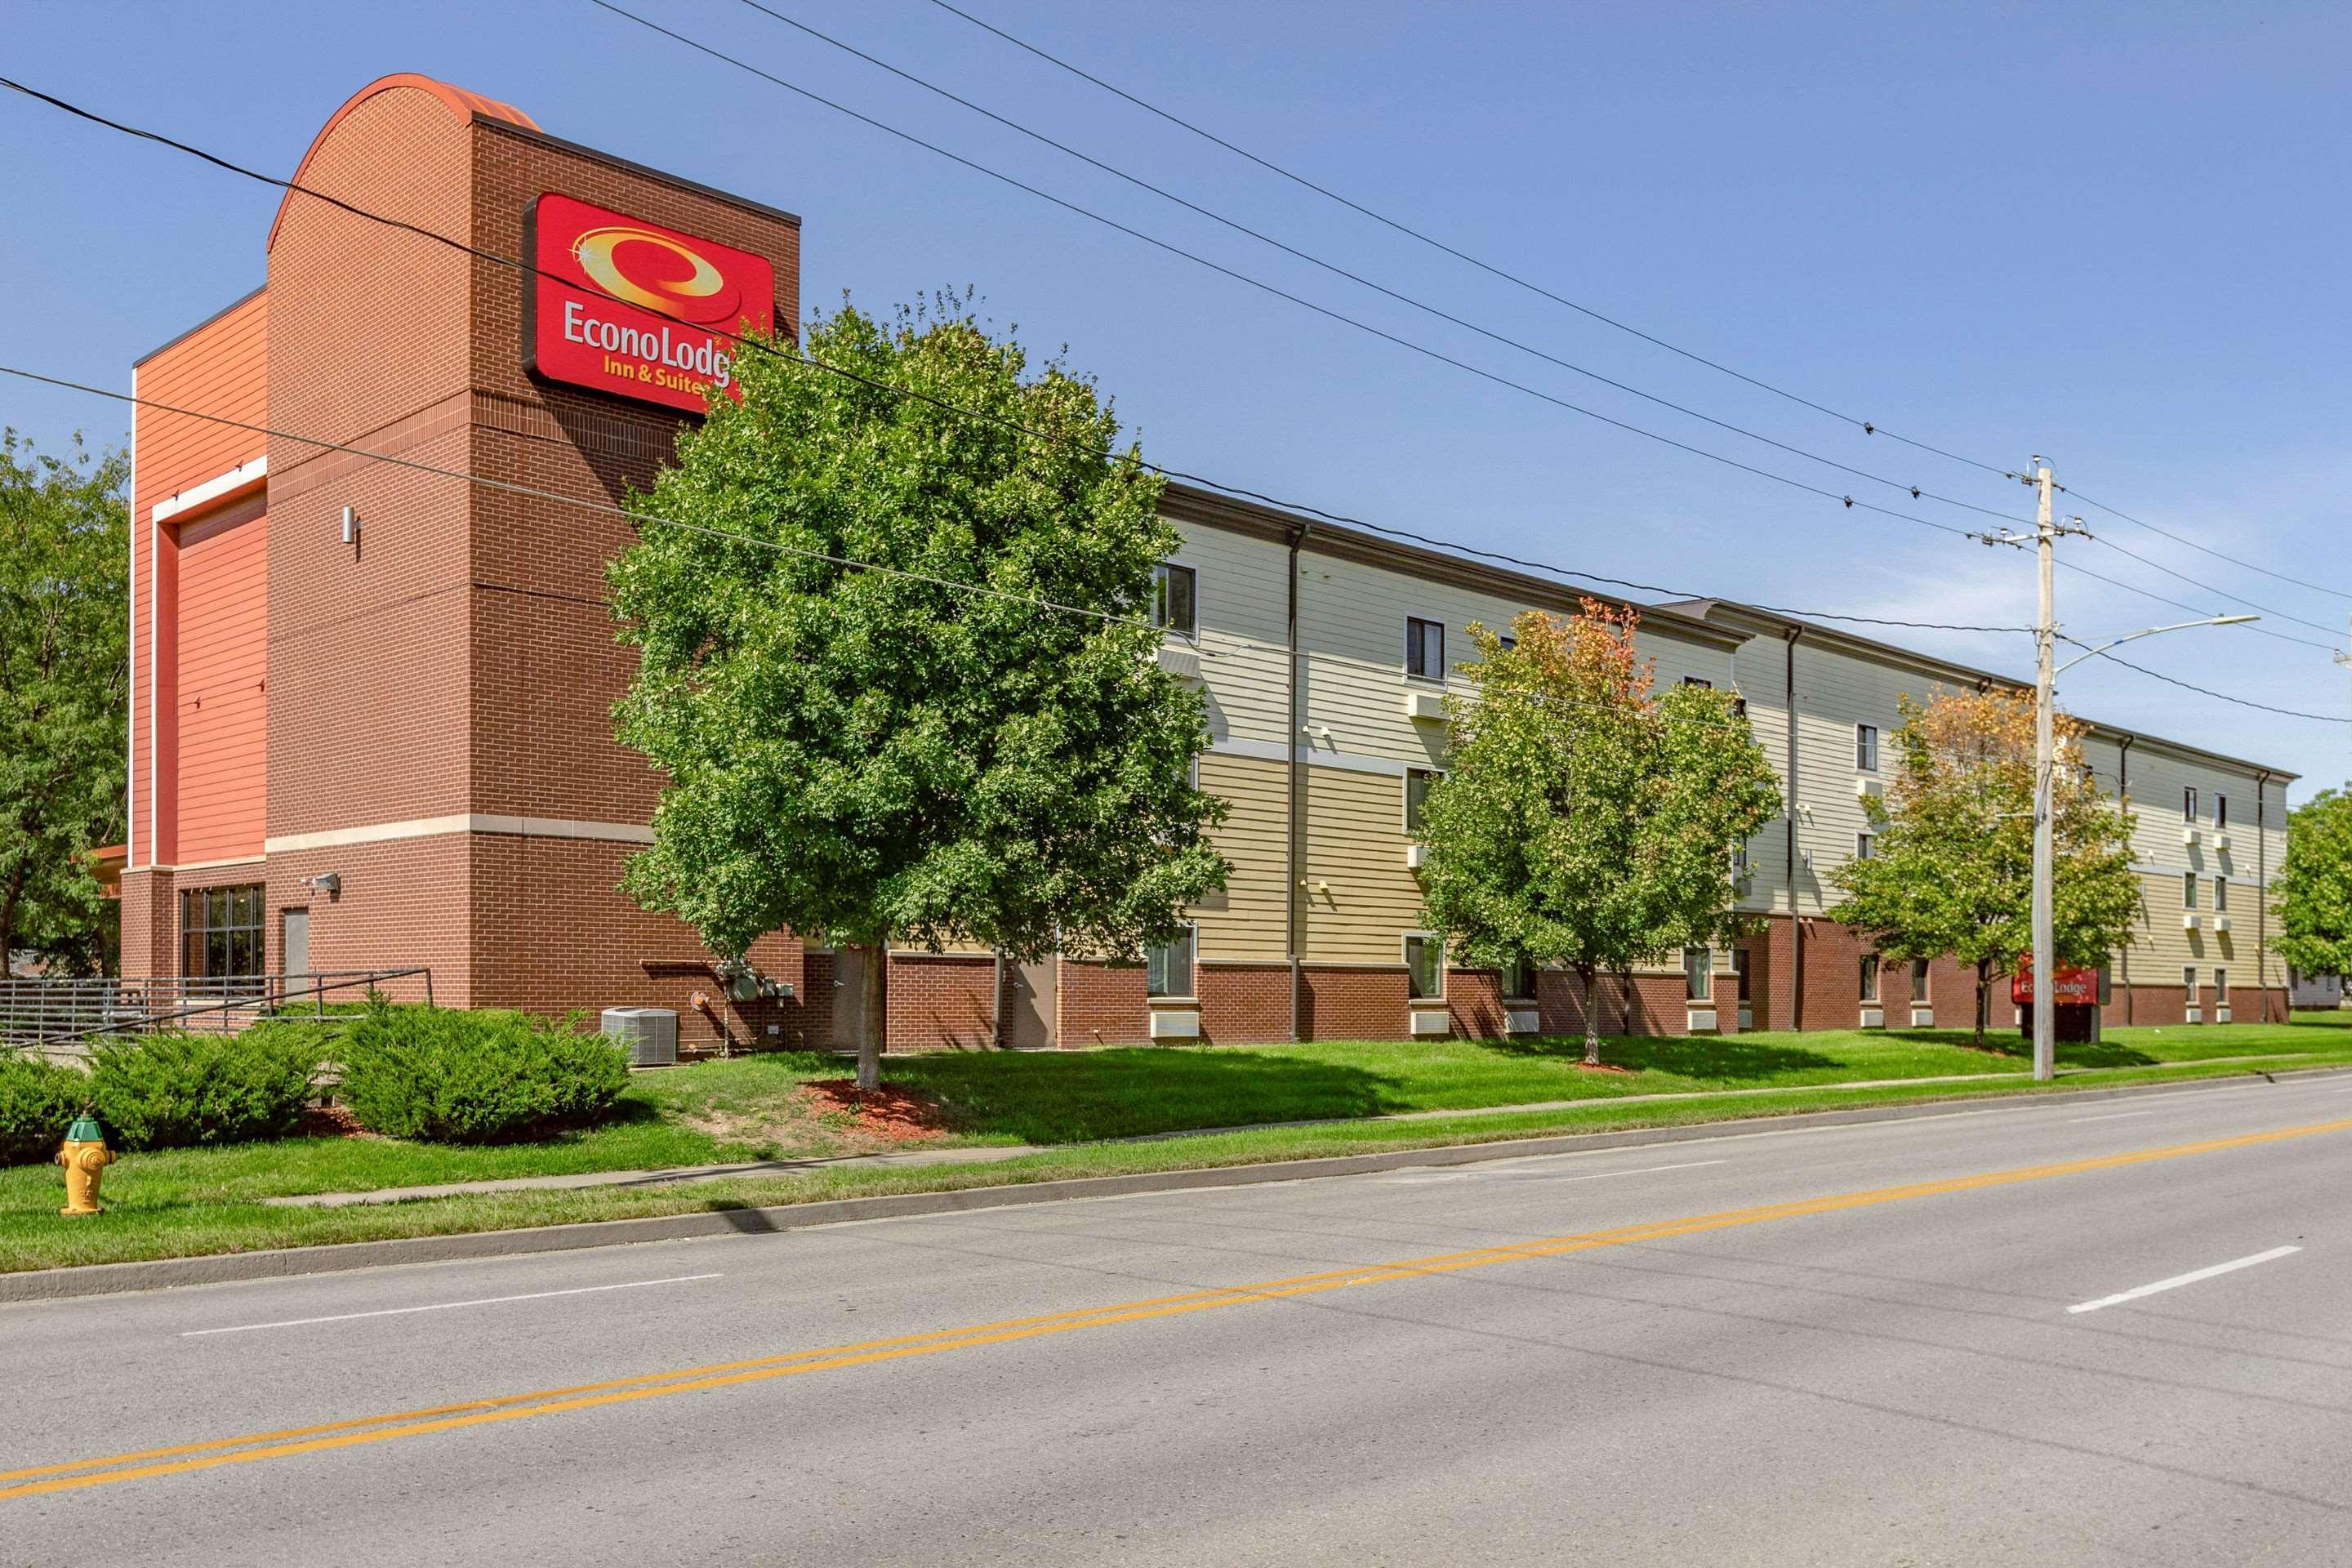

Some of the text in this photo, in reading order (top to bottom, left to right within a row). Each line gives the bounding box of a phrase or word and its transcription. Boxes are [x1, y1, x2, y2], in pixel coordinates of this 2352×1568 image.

[564, 301, 730, 388] EconoLodg
[604, 355, 706, 397] Inn & Suite
[2021, 980, 2087, 995] EcLodge
